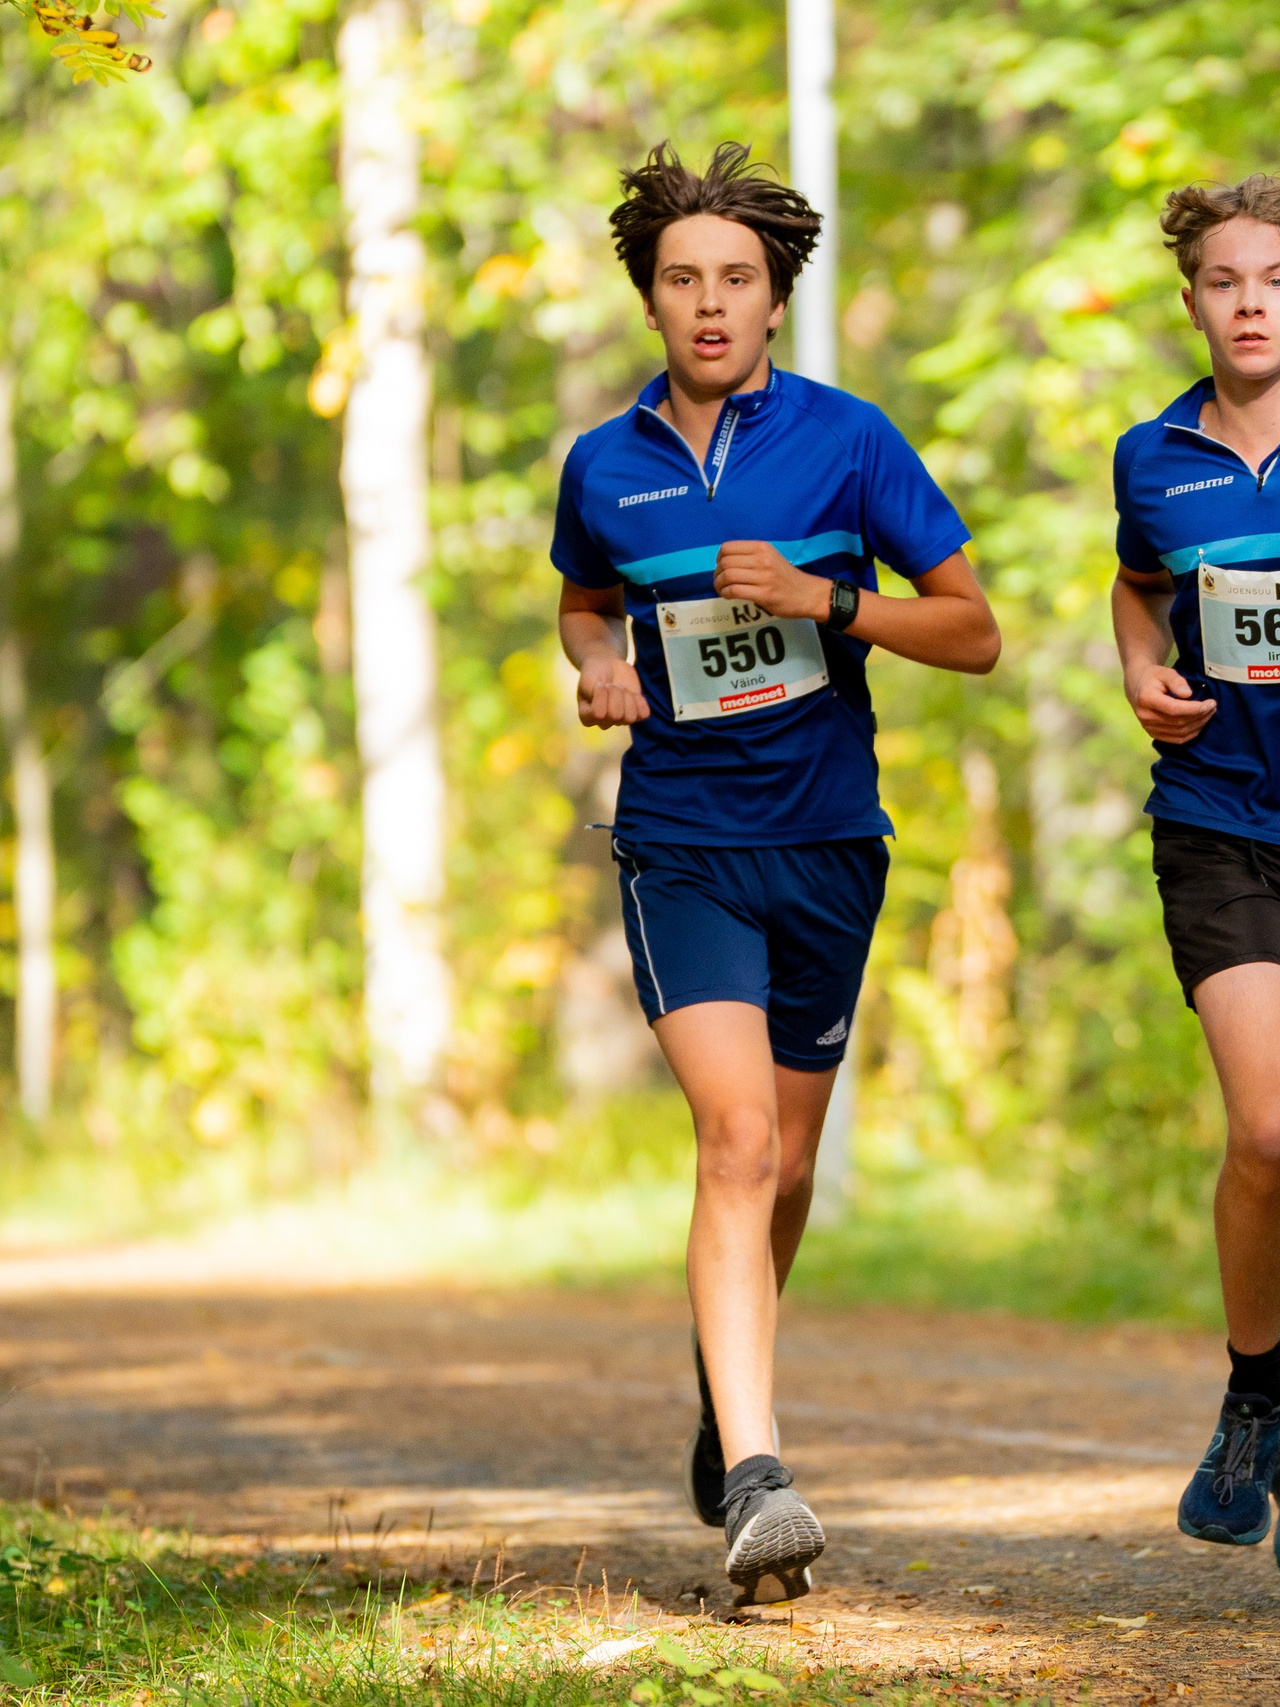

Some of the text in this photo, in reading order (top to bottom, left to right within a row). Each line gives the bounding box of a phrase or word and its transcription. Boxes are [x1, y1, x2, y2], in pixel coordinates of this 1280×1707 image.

[711, 408, 736, 467] noname
[618, 485, 689, 508] noname
[1165, 475, 1234, 498] noname
[1227, 587, 1271, 596] JOENSUU
[689, 604, 774, 626] JOENSUU RU
[698, 625, 786, 678] 550
[730, 674, 766, 690] Väinö
[722, 687, 784, 710] motonet
